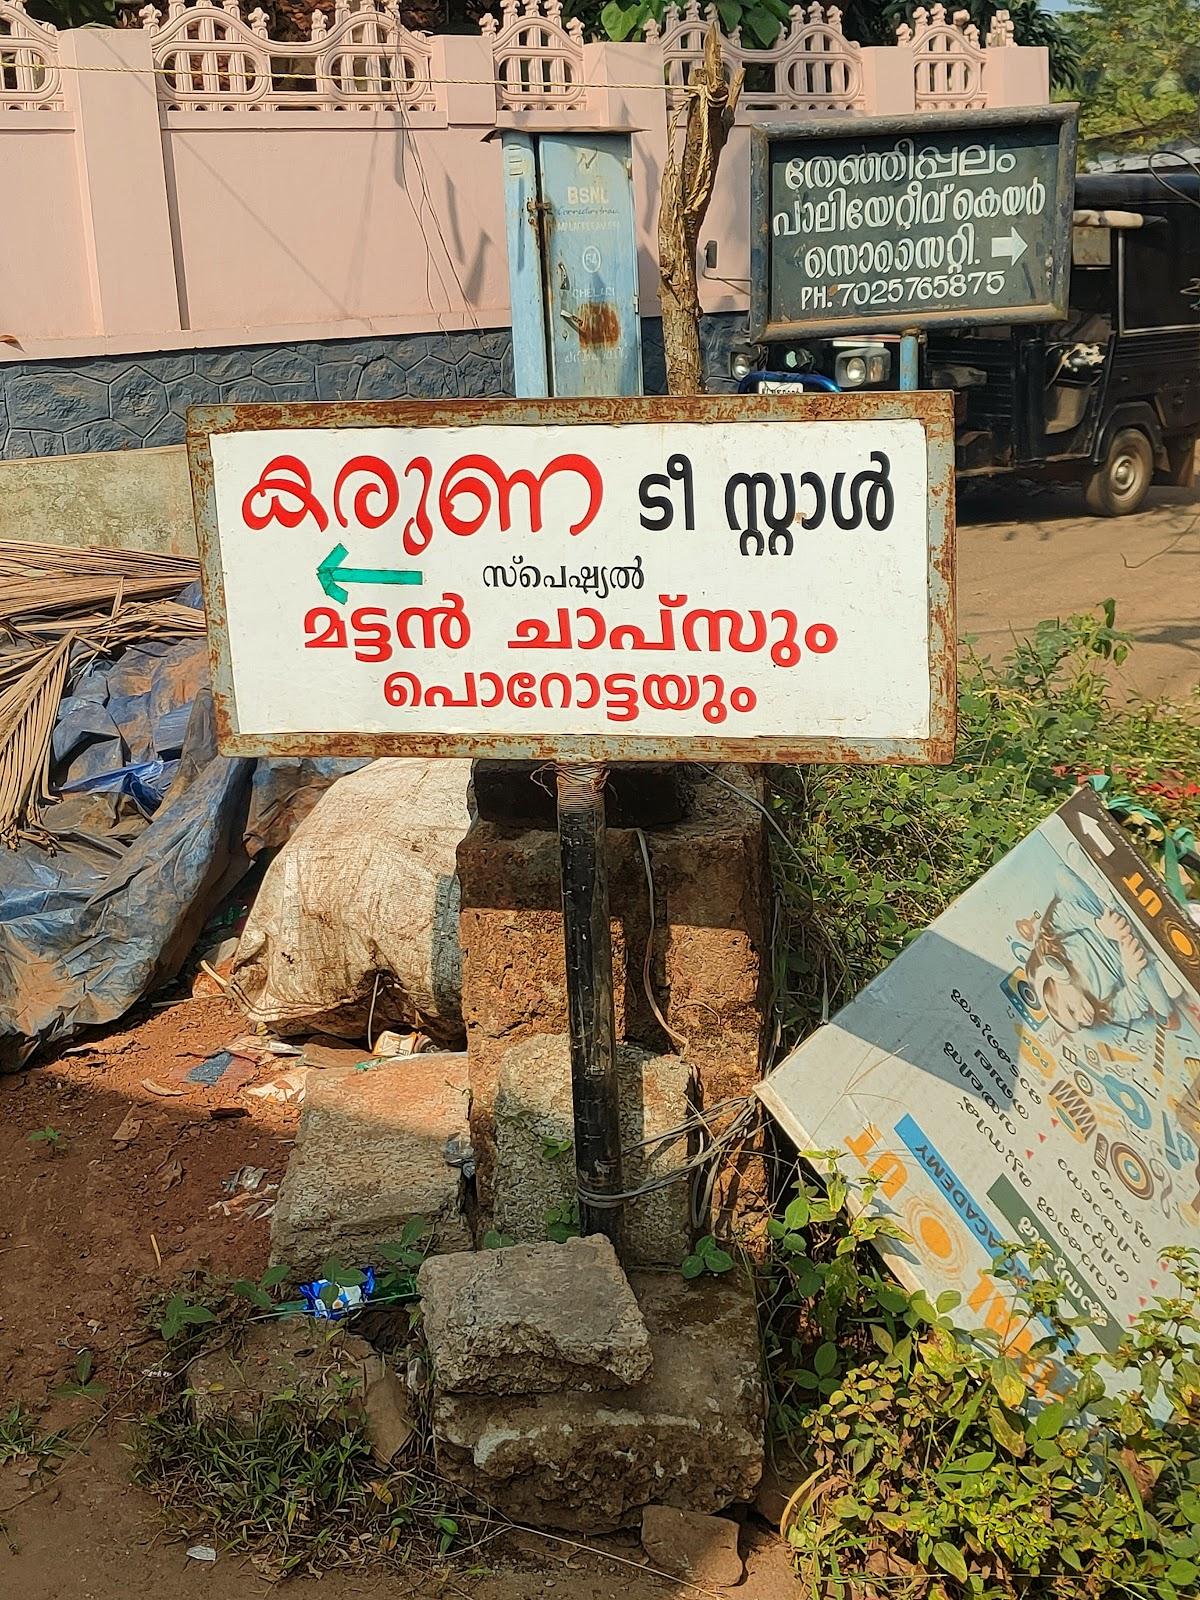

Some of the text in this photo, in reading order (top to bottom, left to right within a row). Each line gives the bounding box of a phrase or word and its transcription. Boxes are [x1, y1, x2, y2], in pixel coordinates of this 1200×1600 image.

[785, 138, 1017, 190] തേഞ്ഞിപ്പലം
[567, 186, 608, 205] BSNL
[773, 177, 1046, 237] പാലിയേറ്റീവ് കെയർ
[801, 271, 1006, 310] PH. 7025765875
[242, 450, 895, 556] കരുണ ടീ സ്റ്റാൾ
[483, 555, 645, 599] സ്പെഷ്യൽ
[304, 593, 838, 667] മട്ടൻ ചാപ്സും
[383, 671, 757, 724] പൊറോട്ടയും
[912, 1143, 1002, 1248] ACADEMY
